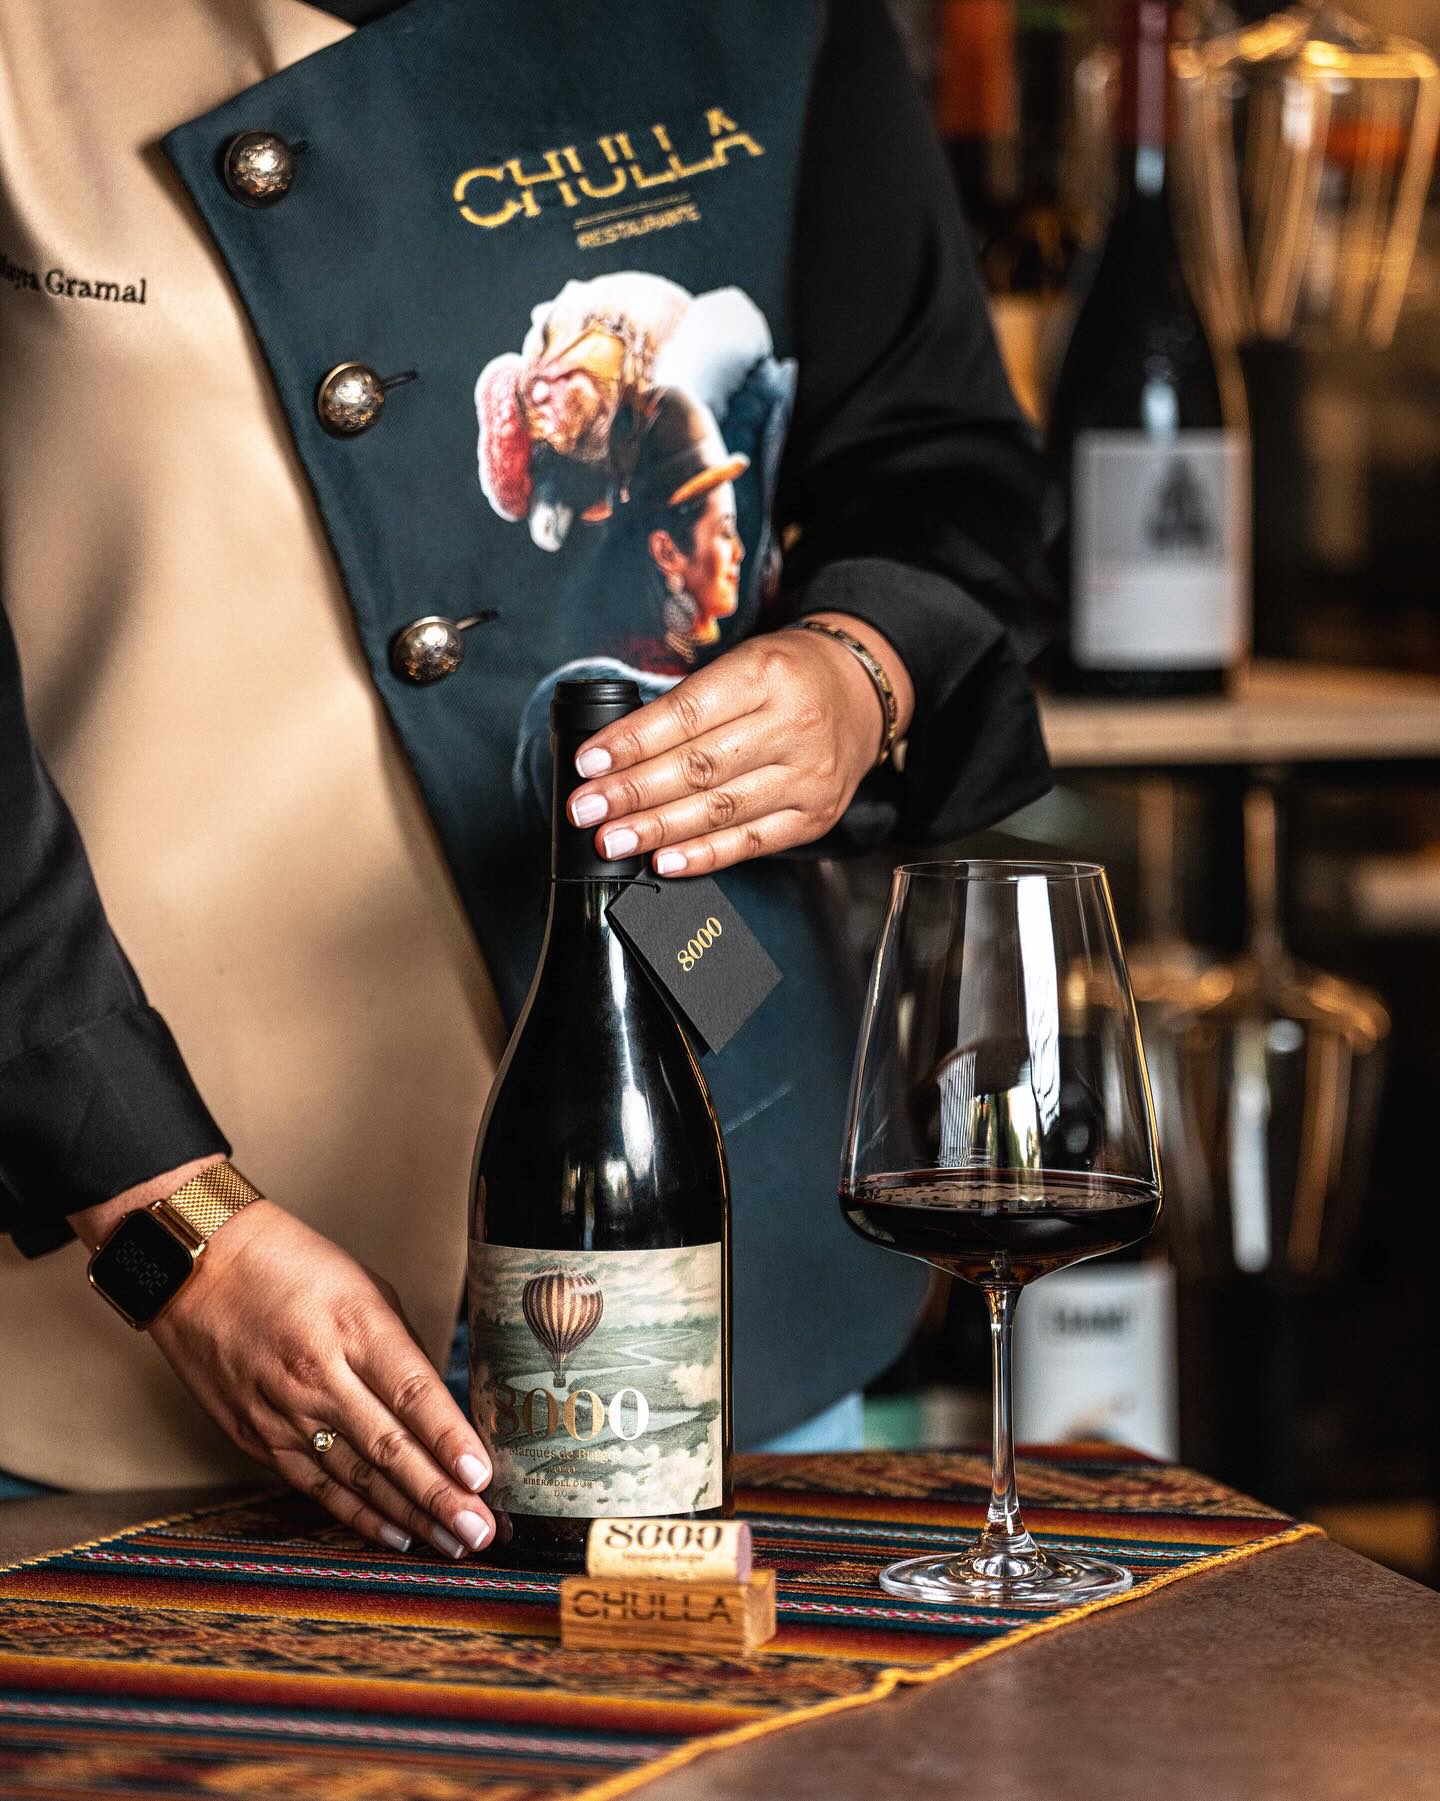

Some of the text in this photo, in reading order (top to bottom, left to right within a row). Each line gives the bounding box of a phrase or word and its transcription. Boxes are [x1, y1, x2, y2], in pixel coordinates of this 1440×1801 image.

[453, 107, 765, 228] CHULLA
[45, 268, 147, 304] Gramal
[677, 916, 722, 972] 8000
[490, 1382, 650, 1441] 8000
[509, 1446, 556, 1461] Marqués
[559, 1447, 574, 1460] de
[554, 1479, 571, 1487] DEL
[605, 1522, 723, 1550] 8000
[572, 1589, 733, 1624] CHULLA
